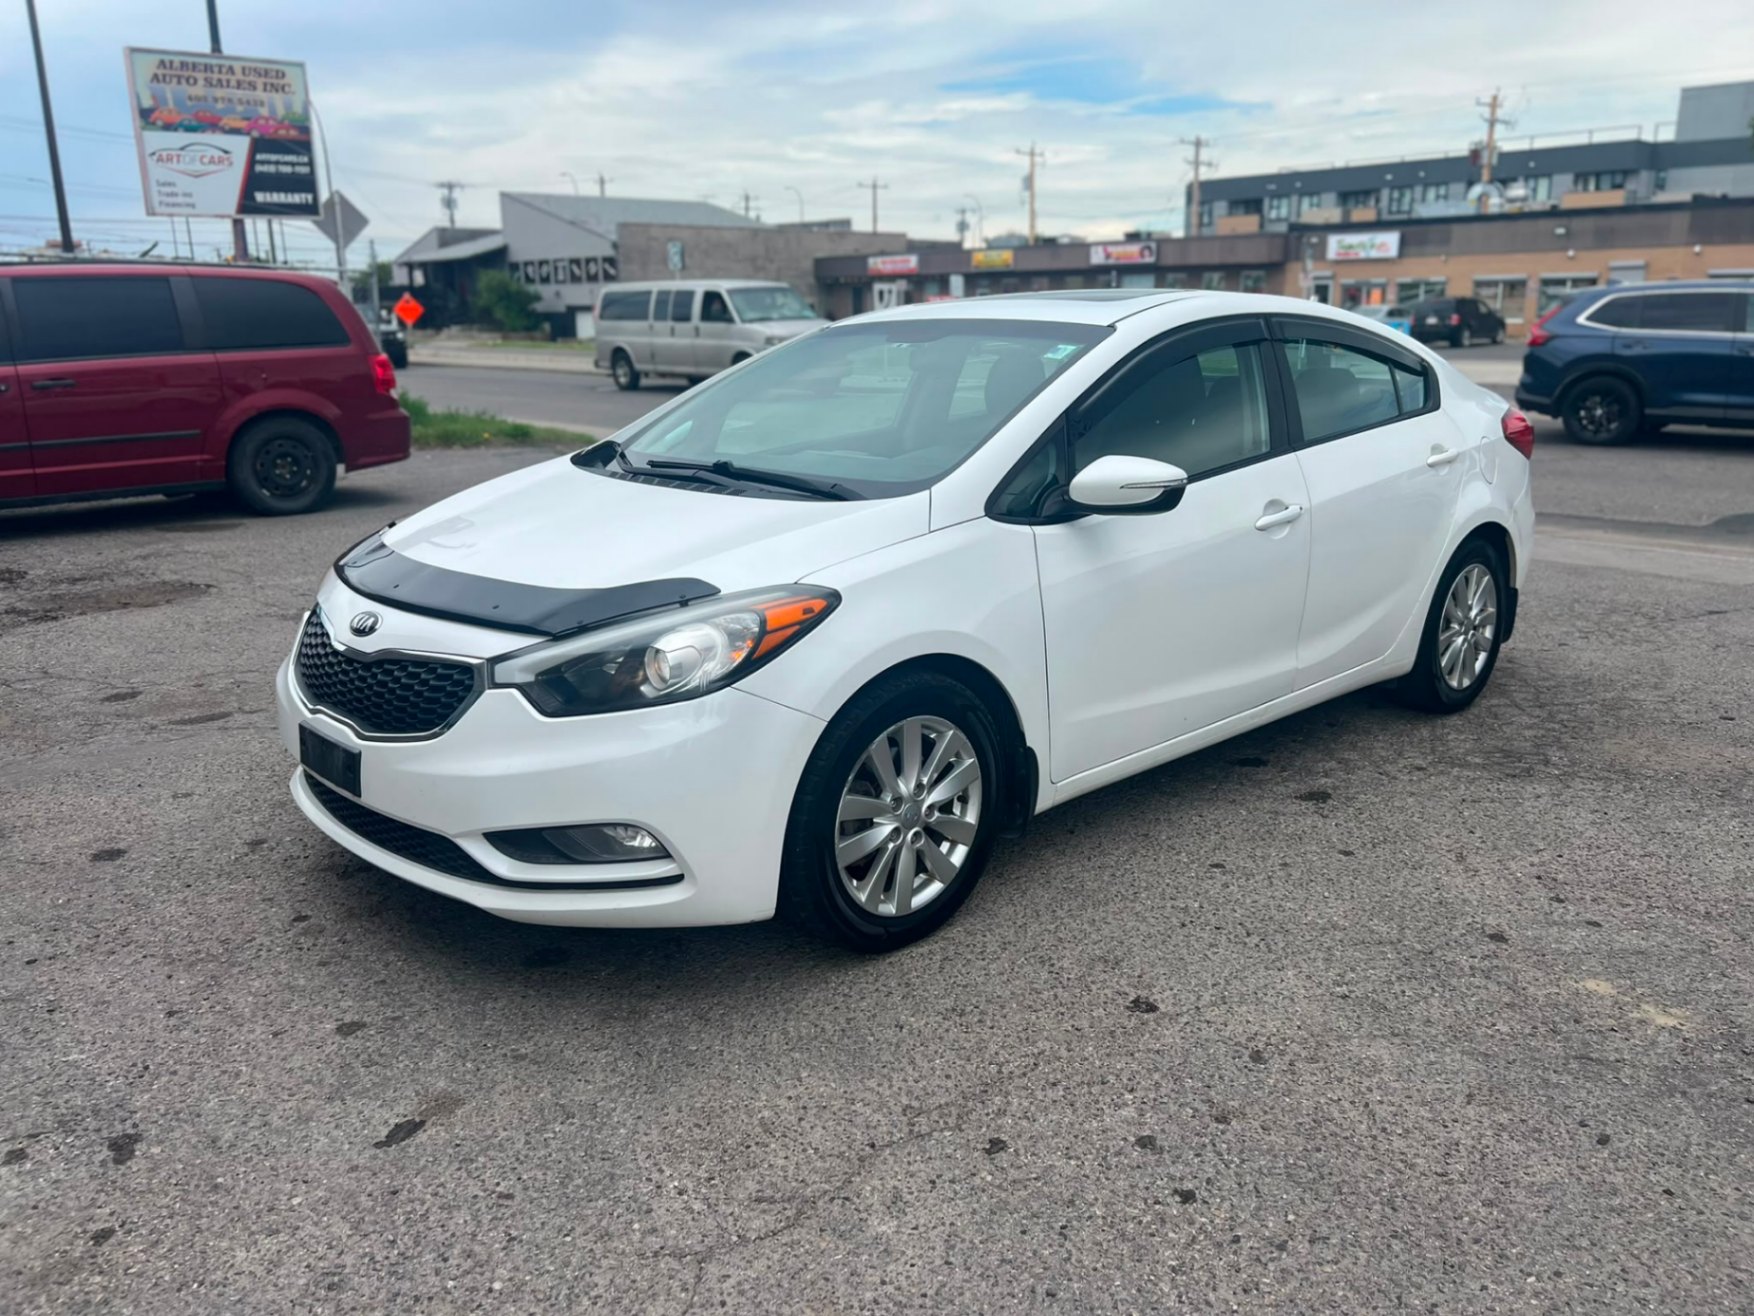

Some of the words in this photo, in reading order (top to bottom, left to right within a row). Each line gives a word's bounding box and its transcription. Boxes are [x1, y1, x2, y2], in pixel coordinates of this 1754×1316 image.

[156, 58, 236, 76] ALBERTA
[242, 66, 287, 80] USED
[150, 72, 199, 86] AUTO
[203, 78, 257, 91] SALES
[156, 154, 182, 164] ART
[199, 155, 234, 167] CARS
[254, 192, 314, 205] WARRANTY
